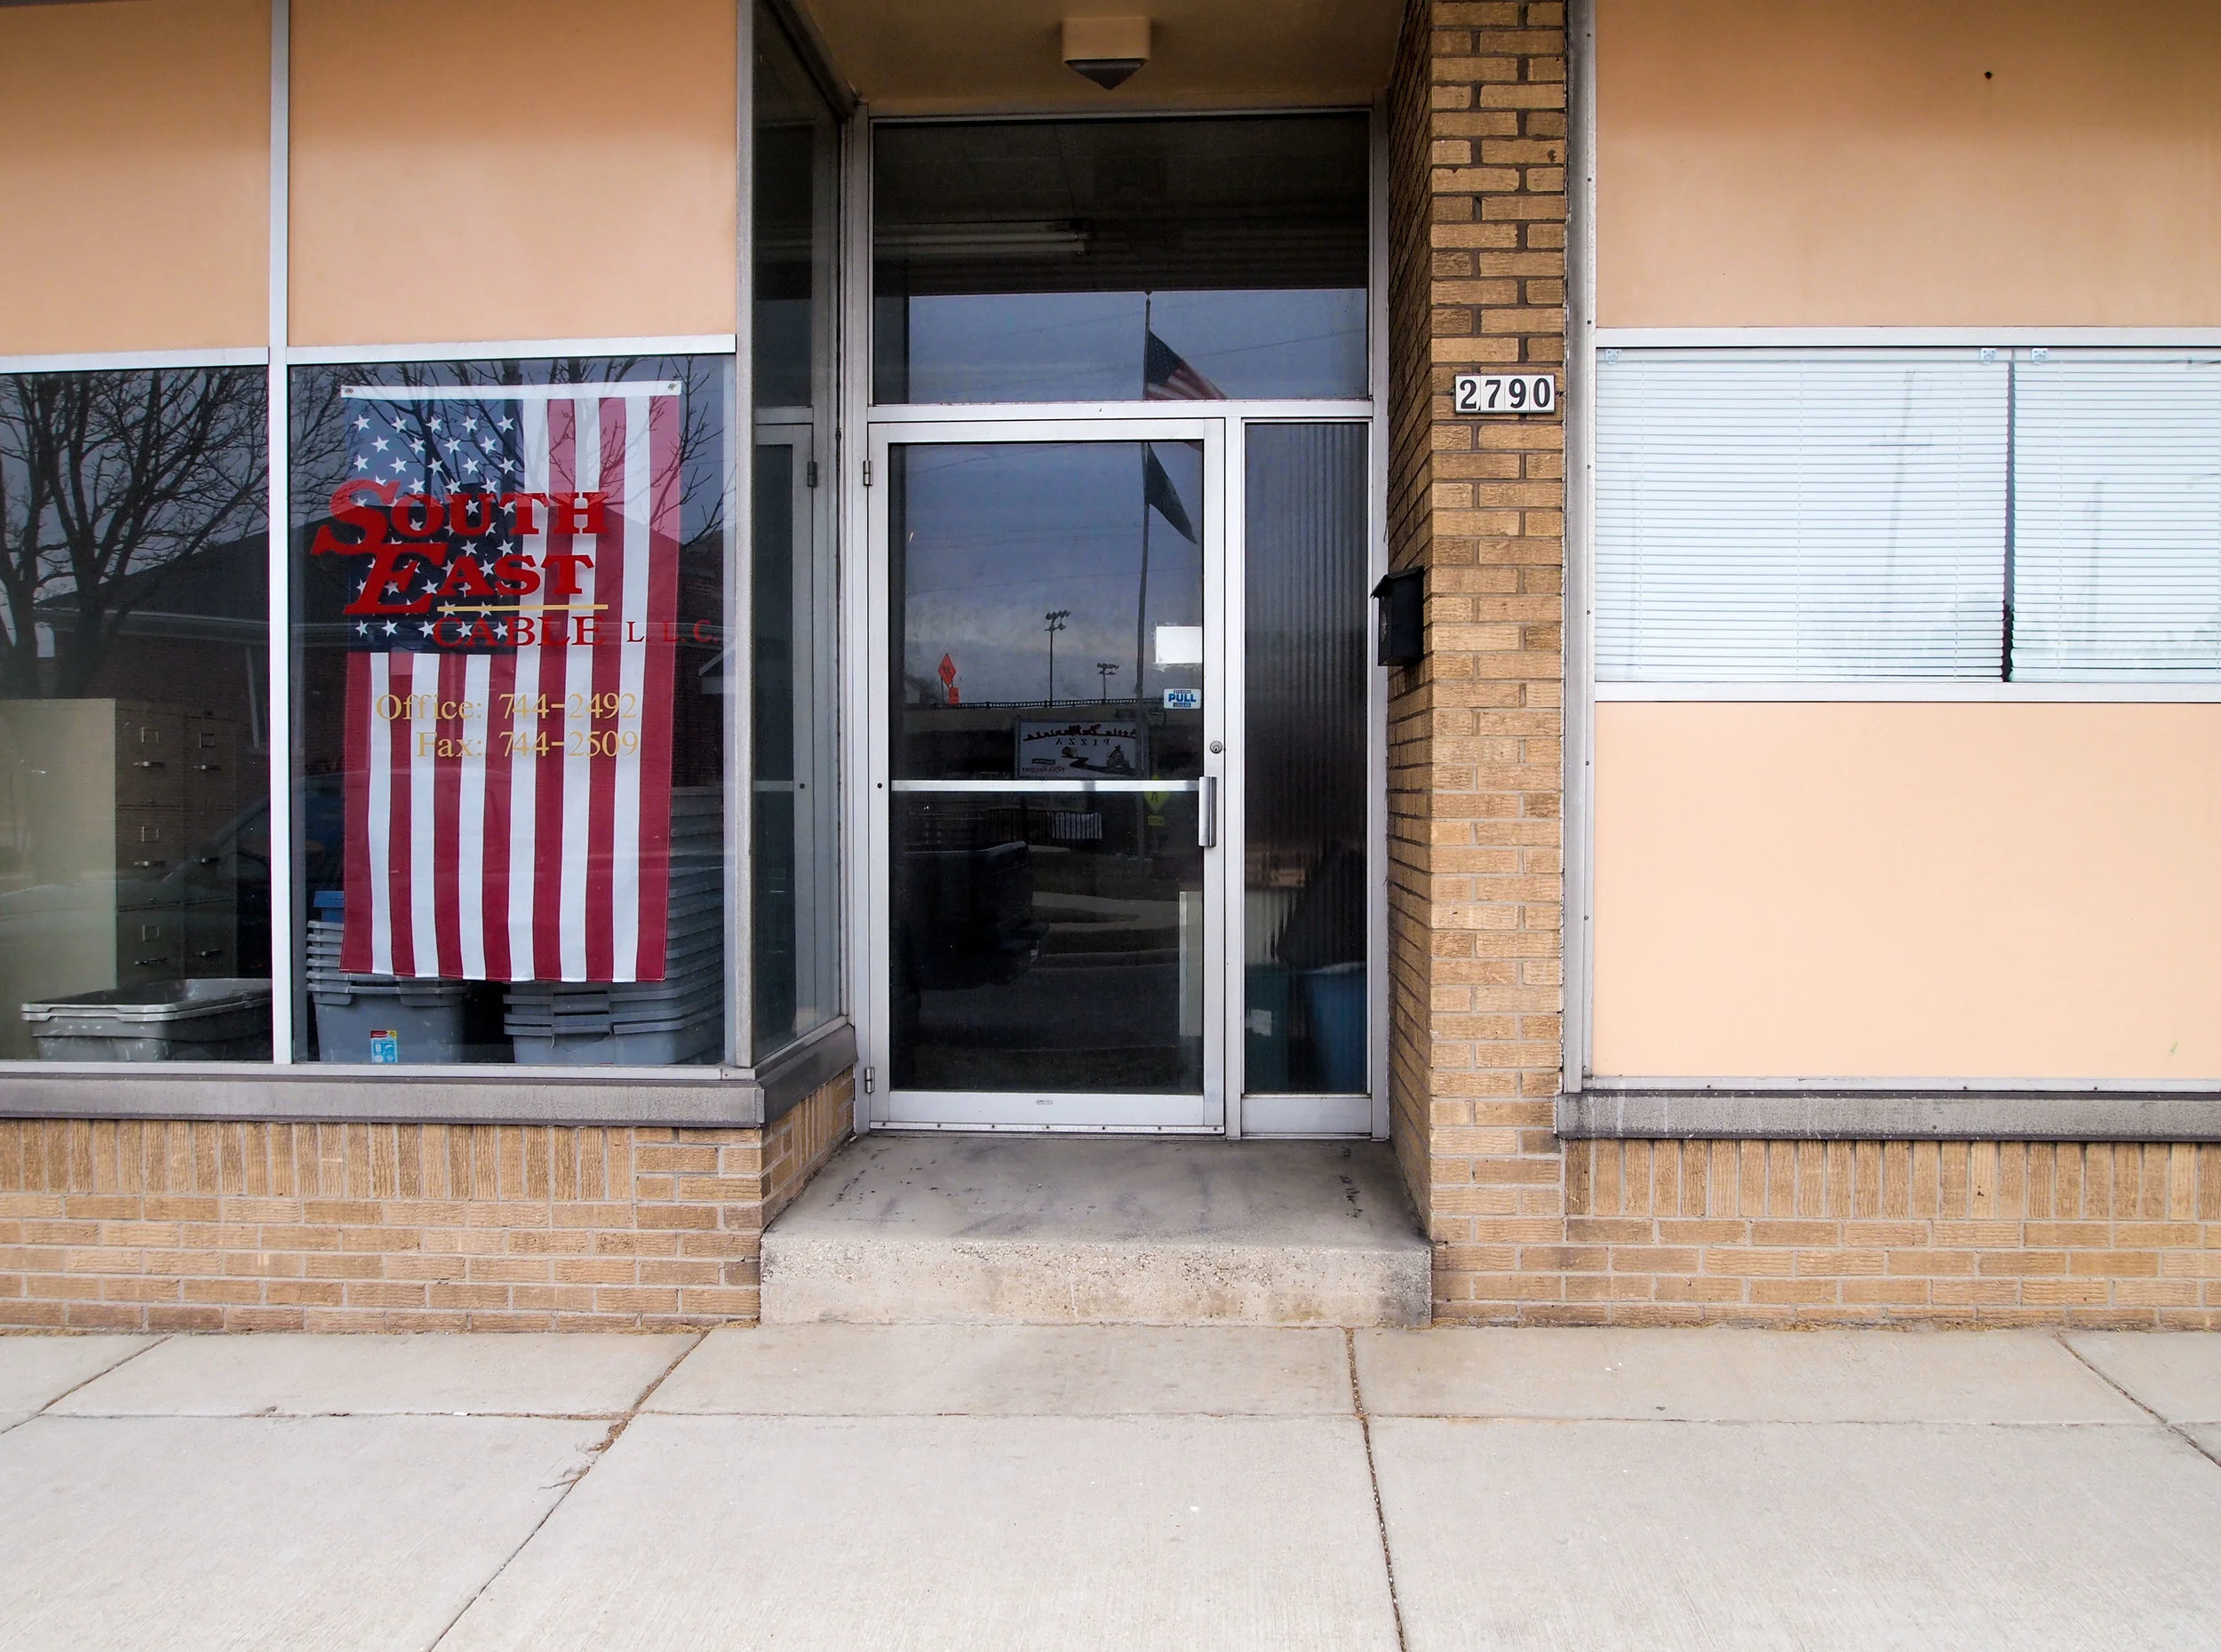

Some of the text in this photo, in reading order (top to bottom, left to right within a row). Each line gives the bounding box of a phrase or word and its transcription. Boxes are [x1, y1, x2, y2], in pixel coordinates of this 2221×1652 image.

[1460, 377, 1551, 409] 2790
[310, 478, 610, 556] SOUTH
[343, 541, 594, 615] EAST
[433, 616, 606, 647] CABLE
[375, 693, 638, 721] Office: 744-2492
[1168, 693, 1197, 703] PULL
[416, 731, 640, 758] Fax: 744-2509
